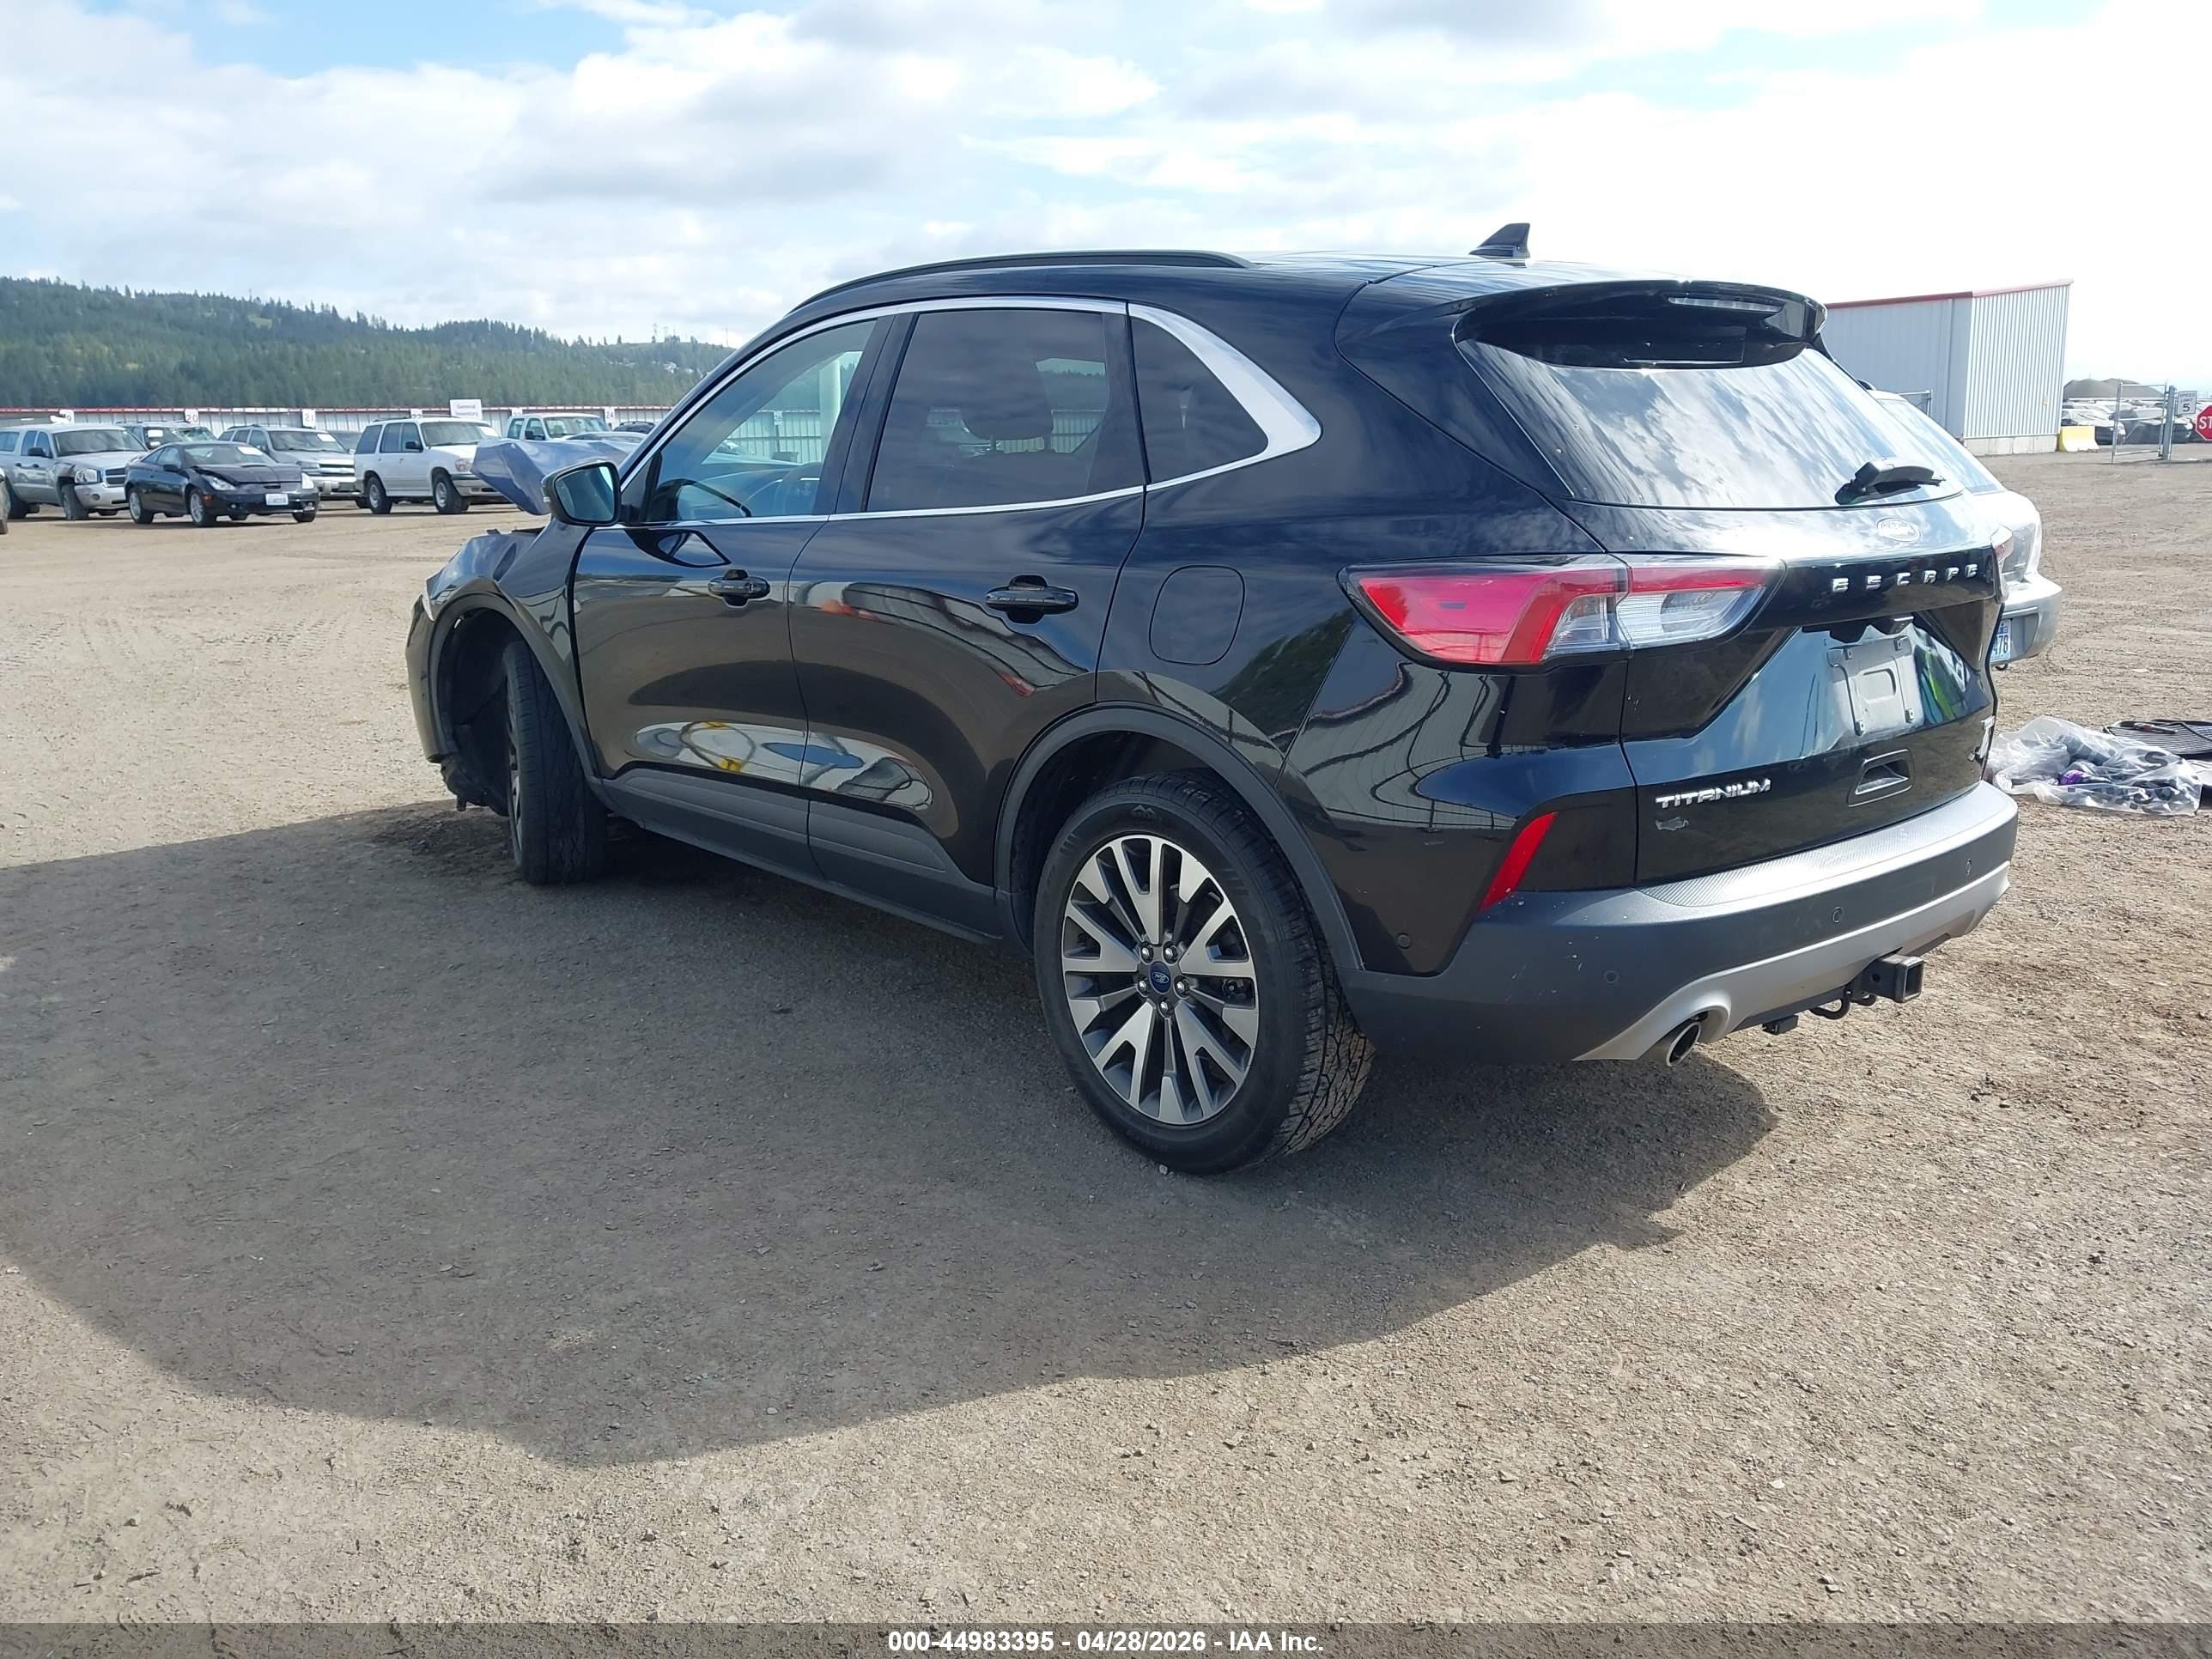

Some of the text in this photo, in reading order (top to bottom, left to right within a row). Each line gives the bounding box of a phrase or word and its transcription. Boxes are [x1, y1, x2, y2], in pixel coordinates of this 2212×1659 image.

[2183, 403, 2191, 412] 5
[186, 414, 198, 422] 20
[304, 412, 314, 422] 21
[1832, 563, 1978, 592] ESCAPE
[1655, 778, 1771, 809] TITANIUM
